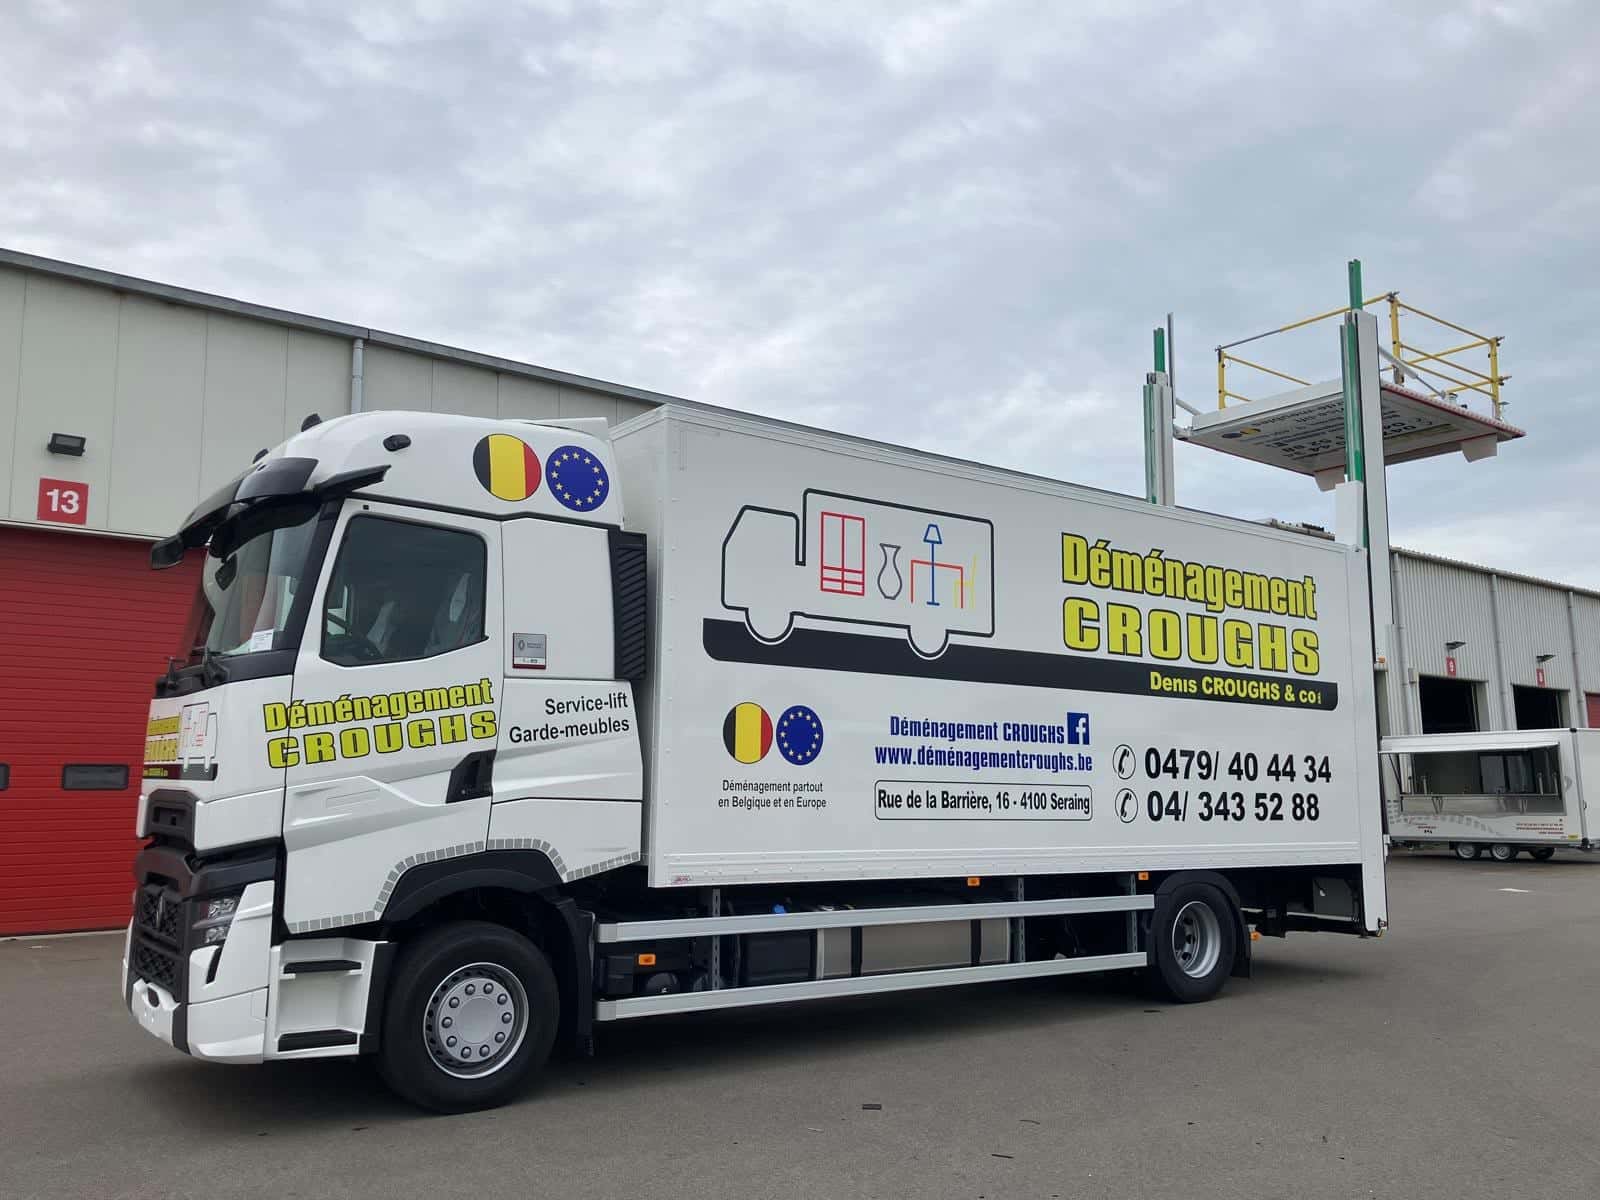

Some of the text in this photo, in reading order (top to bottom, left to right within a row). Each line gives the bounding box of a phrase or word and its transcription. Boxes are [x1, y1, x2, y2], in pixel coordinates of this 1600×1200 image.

[46, 488, 80, 514] 13
[1061, 532, 1318, 621] Déménagement
[1062, 596, 1320, 676] CROUGHS
[1150, 671, 1198, 694] Denis
[1201, 675, 1281, 701] CROUGHS
[1284, 684, 1296, 702] &
[263, 678, 494, 732] Déménagement
[545, 691, 628, 715] Service-lift
[267, 710, 498, 769] CROUGHS
[509, 717, 630, 743] Garde-meubles
[890, 715, 999, 742] Déménagement
[1003, 722, 1065, 744] CROUGHS
[875, 745, 1093, 773] www.déménagementcroughs.be
[1144, 747, 1332, 783] 0479/ 40 44 34
[722, 779, 823, 794] Déménagement partout
[718, 795, 827, 810] en Belgique et en Europe
[878, 789, 902, 809] Rue
[907, 789, 922, 809] de
[926, 790, 937, 809] la
[941, 790, 992, 813] Barrière,
[996, 792, 1010, 810] 16
[1020, 792, 1047, 810] 4100
[1050, 793, 1090, 814] Seraing
[1147, 790, 1320, 822] 04/ 343 52 88
